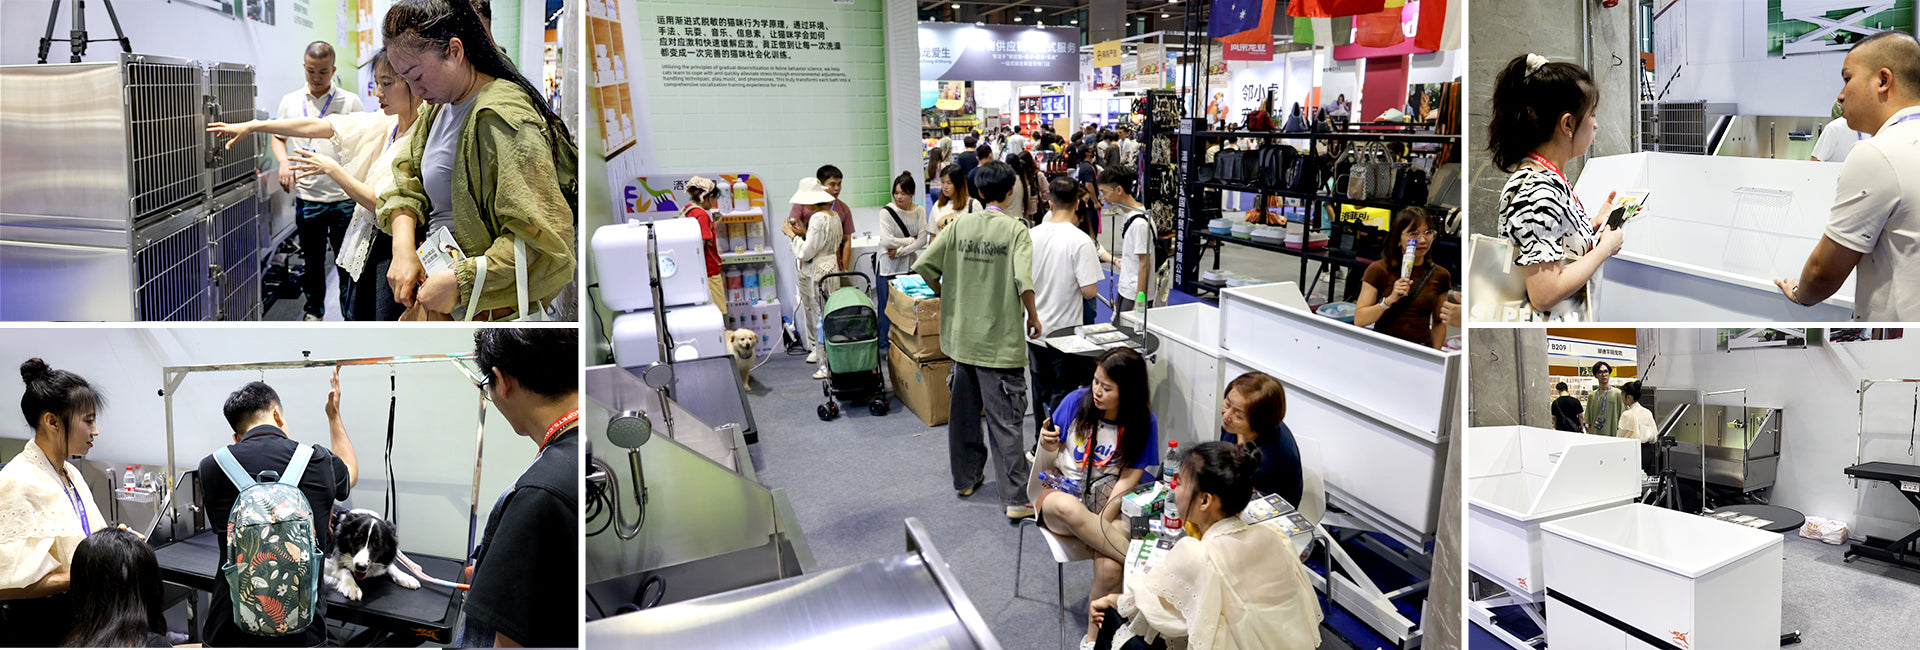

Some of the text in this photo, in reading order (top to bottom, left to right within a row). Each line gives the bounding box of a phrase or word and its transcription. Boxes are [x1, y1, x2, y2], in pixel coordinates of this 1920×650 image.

[657, 15, 830, 31] 运用渐进式脱敏的猫咪行为学原理，通过环境、
[658, 26, 825, 40] 手法、玩耍、音乐、信息素，让猫咪学会如何
[660, 48, 792, 60] 都变成一次完善的猫咪社会化训练。
